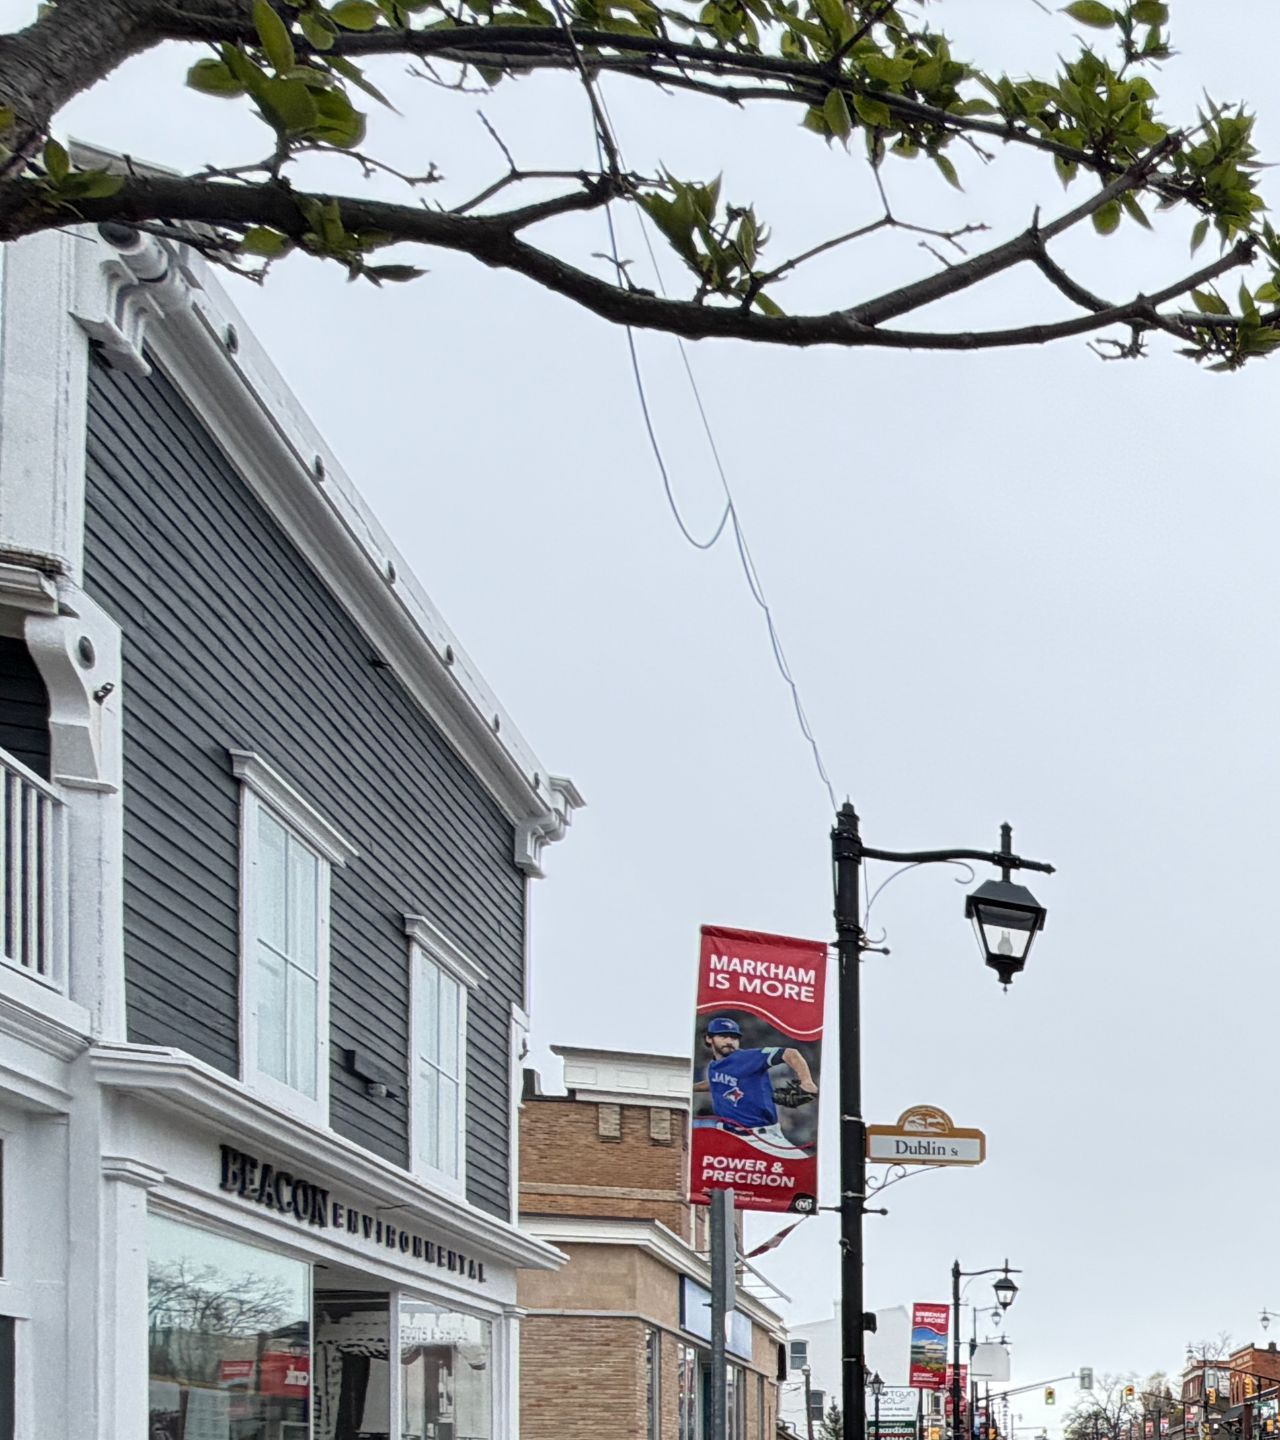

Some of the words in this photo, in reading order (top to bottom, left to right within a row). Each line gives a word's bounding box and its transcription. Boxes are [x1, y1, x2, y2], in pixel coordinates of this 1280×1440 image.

[710, 953, 816, 985] MARKHAM
[708, 971, 731, 990] IS
[738, 976, 815, 1003] MORE
[711, 1071, 738, 1087] JAYS
[895, 1139, 946, 1156] Dublin
[950, 1147, 959, 1156] St
[702, 1155, 767, 1172] POWER
[770, 1161, 785, 1174] &
[701, 1169, 796, 1188] PRECISION
[218, 1144, 330, 1228] BEACON
[332, 1202, 487, 1283] ENVIRONMENTAL
